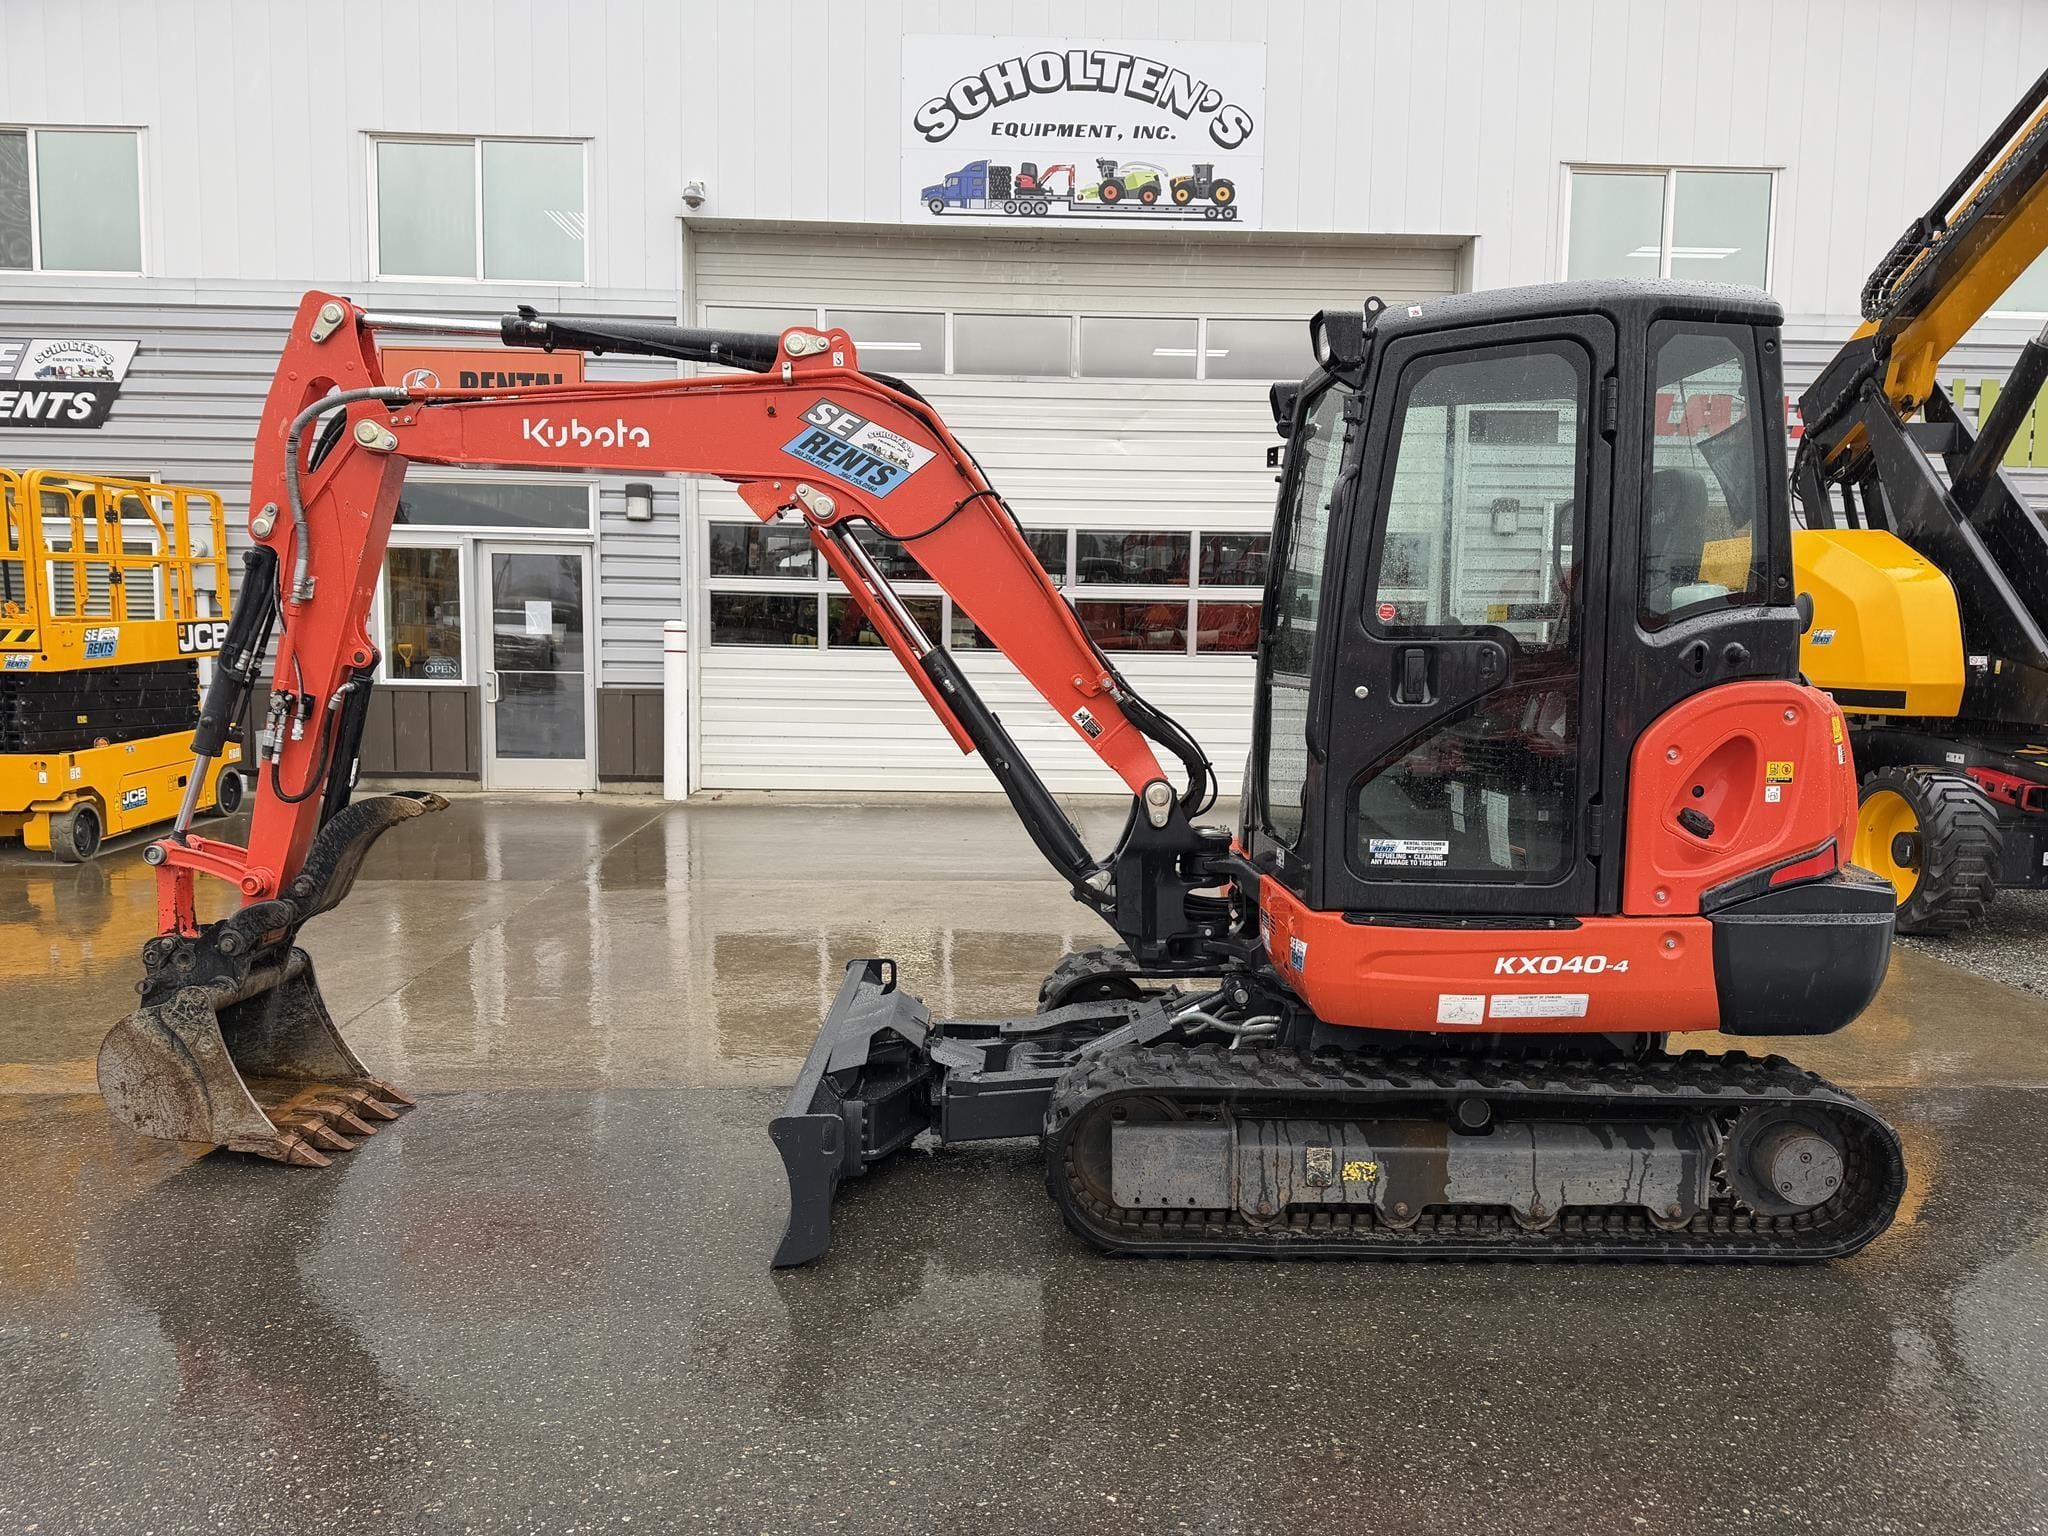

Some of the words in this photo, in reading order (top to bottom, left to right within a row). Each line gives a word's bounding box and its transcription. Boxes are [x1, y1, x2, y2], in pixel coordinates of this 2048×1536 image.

[914, 50, 1254, 149] SCHOLTEN'S
[991, 122, 1123, 141] EQUIPMENT,
[1133, 125, 1177, 140] INC.
[34, 341, 114, 365] SCHOLTEN'S
[807, 403, 861, 436] SE
[523, 418, 650, 448] Kubota
[798, 431, 898, 486] RENTS
[87, 641, 115, 655] RENTS
[179, 622, 228, 652] JCB
[425, 665, 457, 673] OPEN
[123, 788, 147, 804] JCB
[1494, 955, 1629, 974] KX040-4
